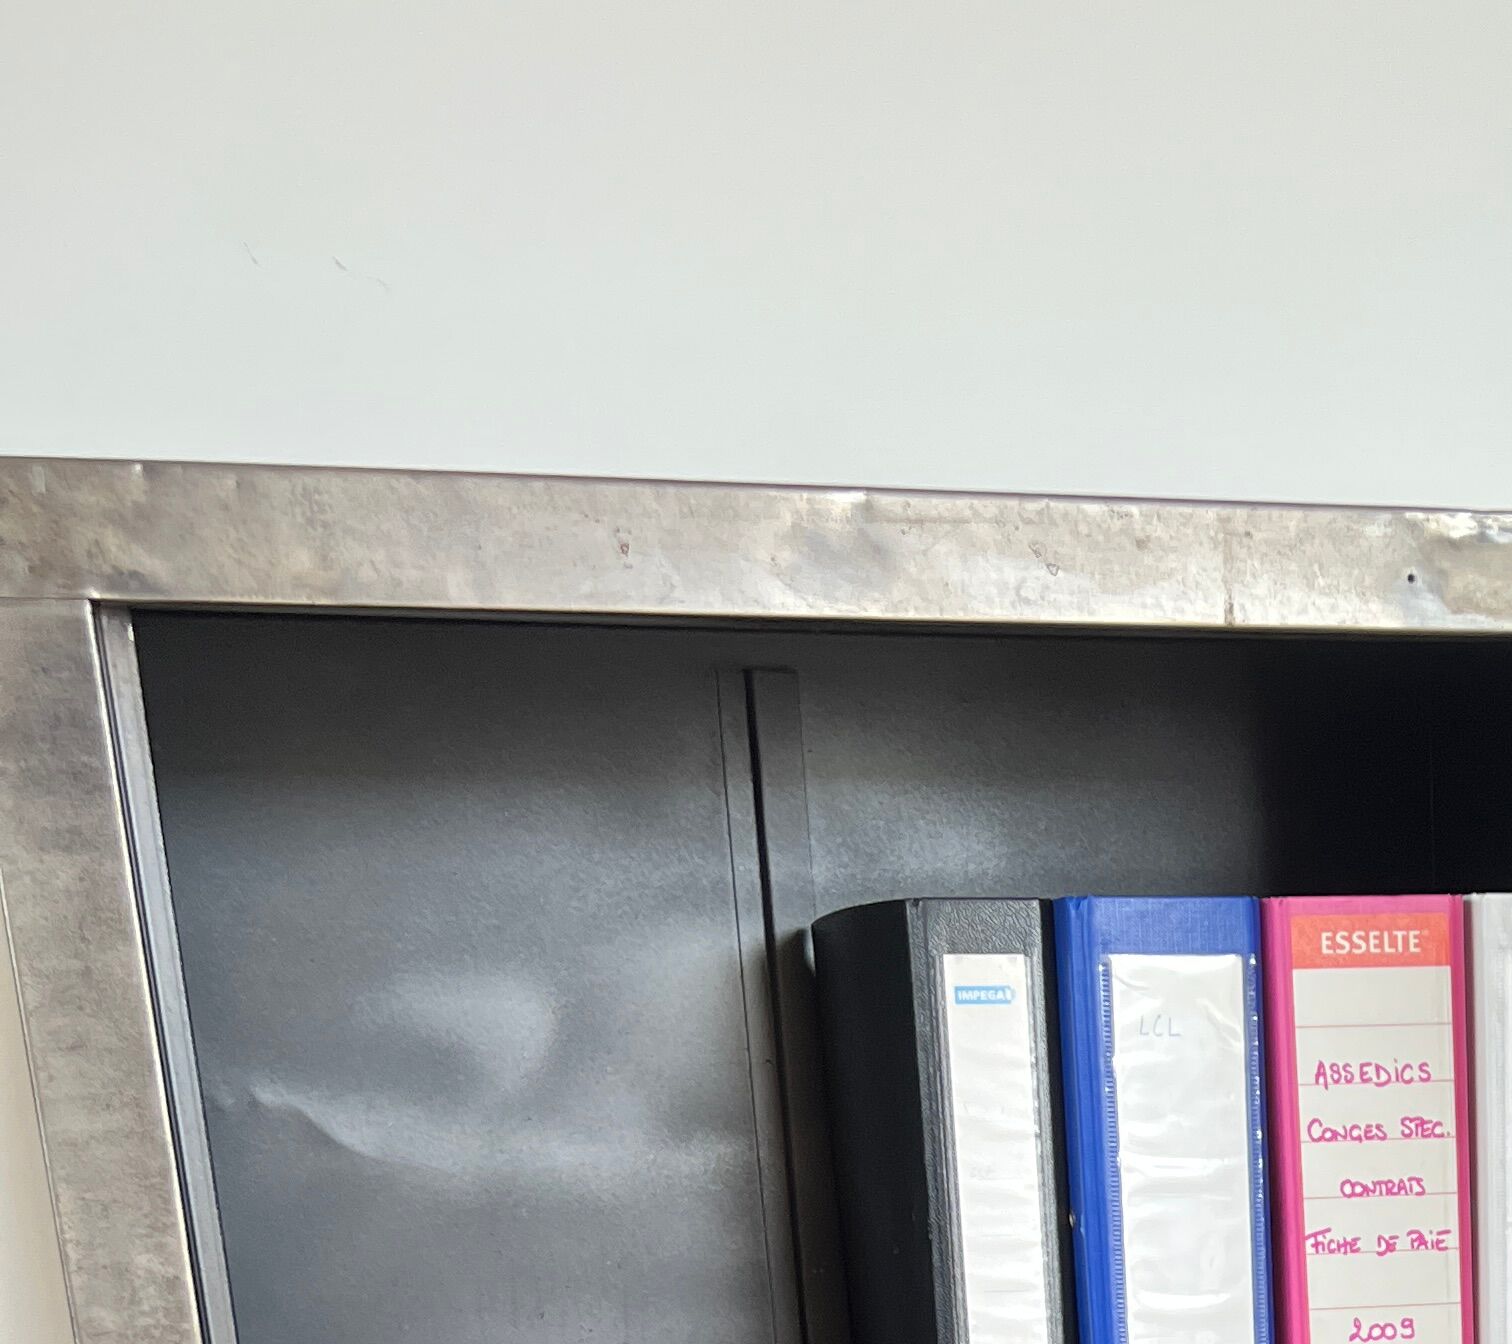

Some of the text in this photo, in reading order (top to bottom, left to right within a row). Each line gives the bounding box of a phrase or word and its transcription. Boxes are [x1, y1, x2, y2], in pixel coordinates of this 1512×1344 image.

[1320, 929, 1422, 955] ESSELTE
[956, 989, 1004, 1001] IMPEGA
[1139, 1014, 1181, 1037] LCL
[1307, 1117, 1388, 1144] CONGES
[1340, 1176, 1426, 1199] CONTRATS
[1376, 1234, 1400, 1257] DE
[1348, 1317, 1416, 1343] 2009
